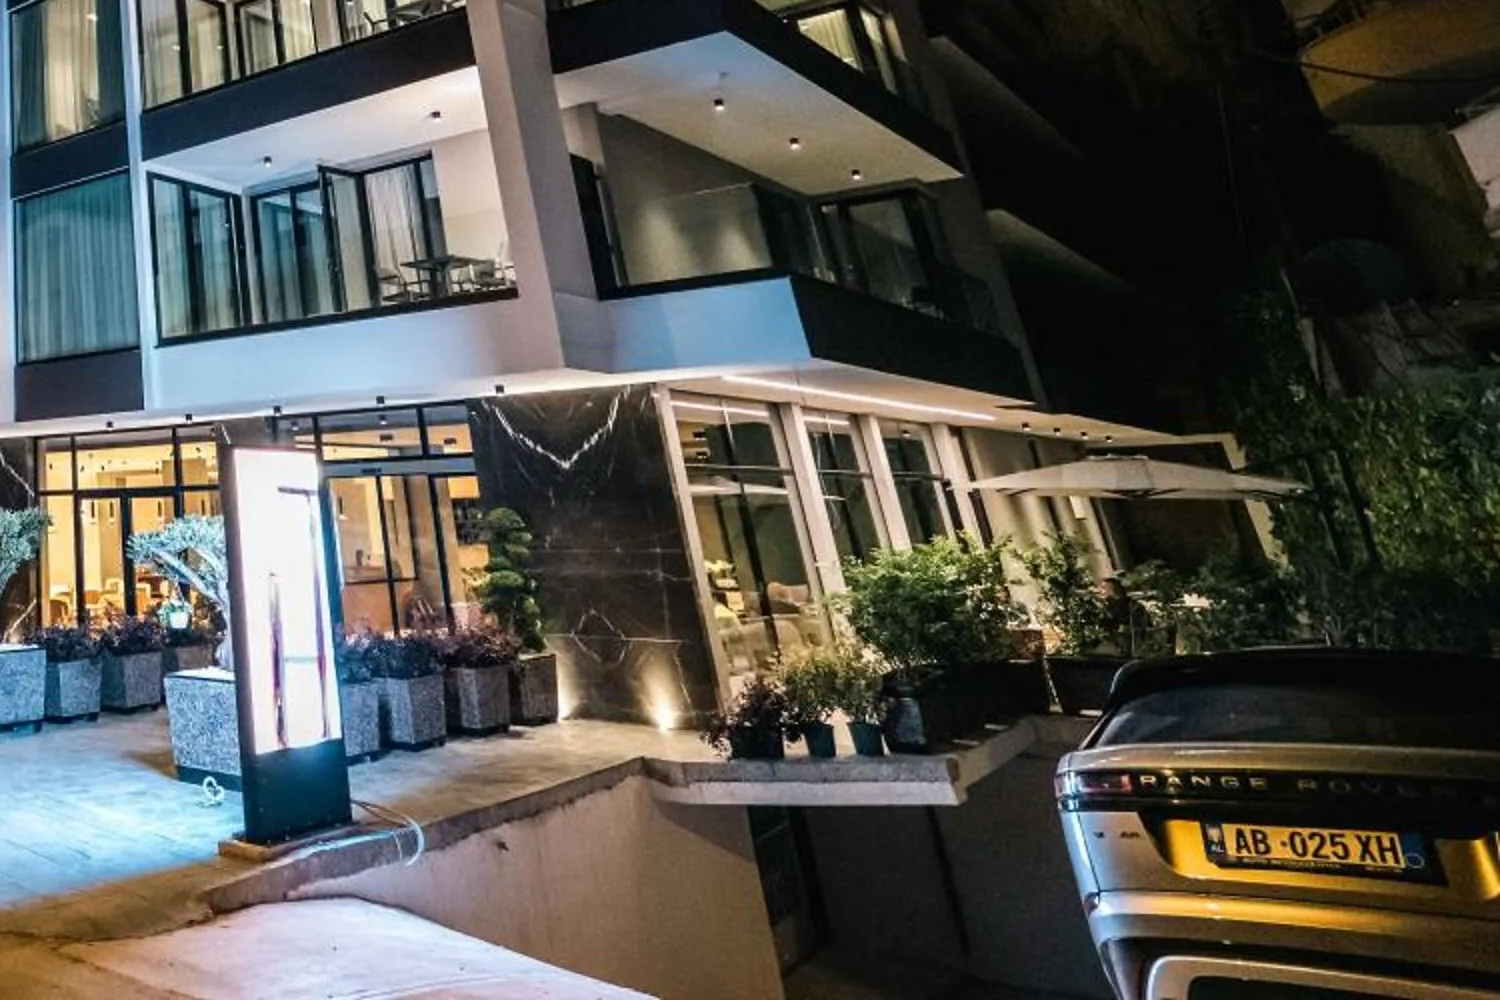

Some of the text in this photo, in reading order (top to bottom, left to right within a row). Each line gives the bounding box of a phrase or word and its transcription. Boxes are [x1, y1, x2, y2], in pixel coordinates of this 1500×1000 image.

[1140, 775, 1268, 791] RANGE
[1234, 826, 1271, 856] AB
[1288, 831, 1350, 859] 025
[1356, 835, 1401, 866] XH
